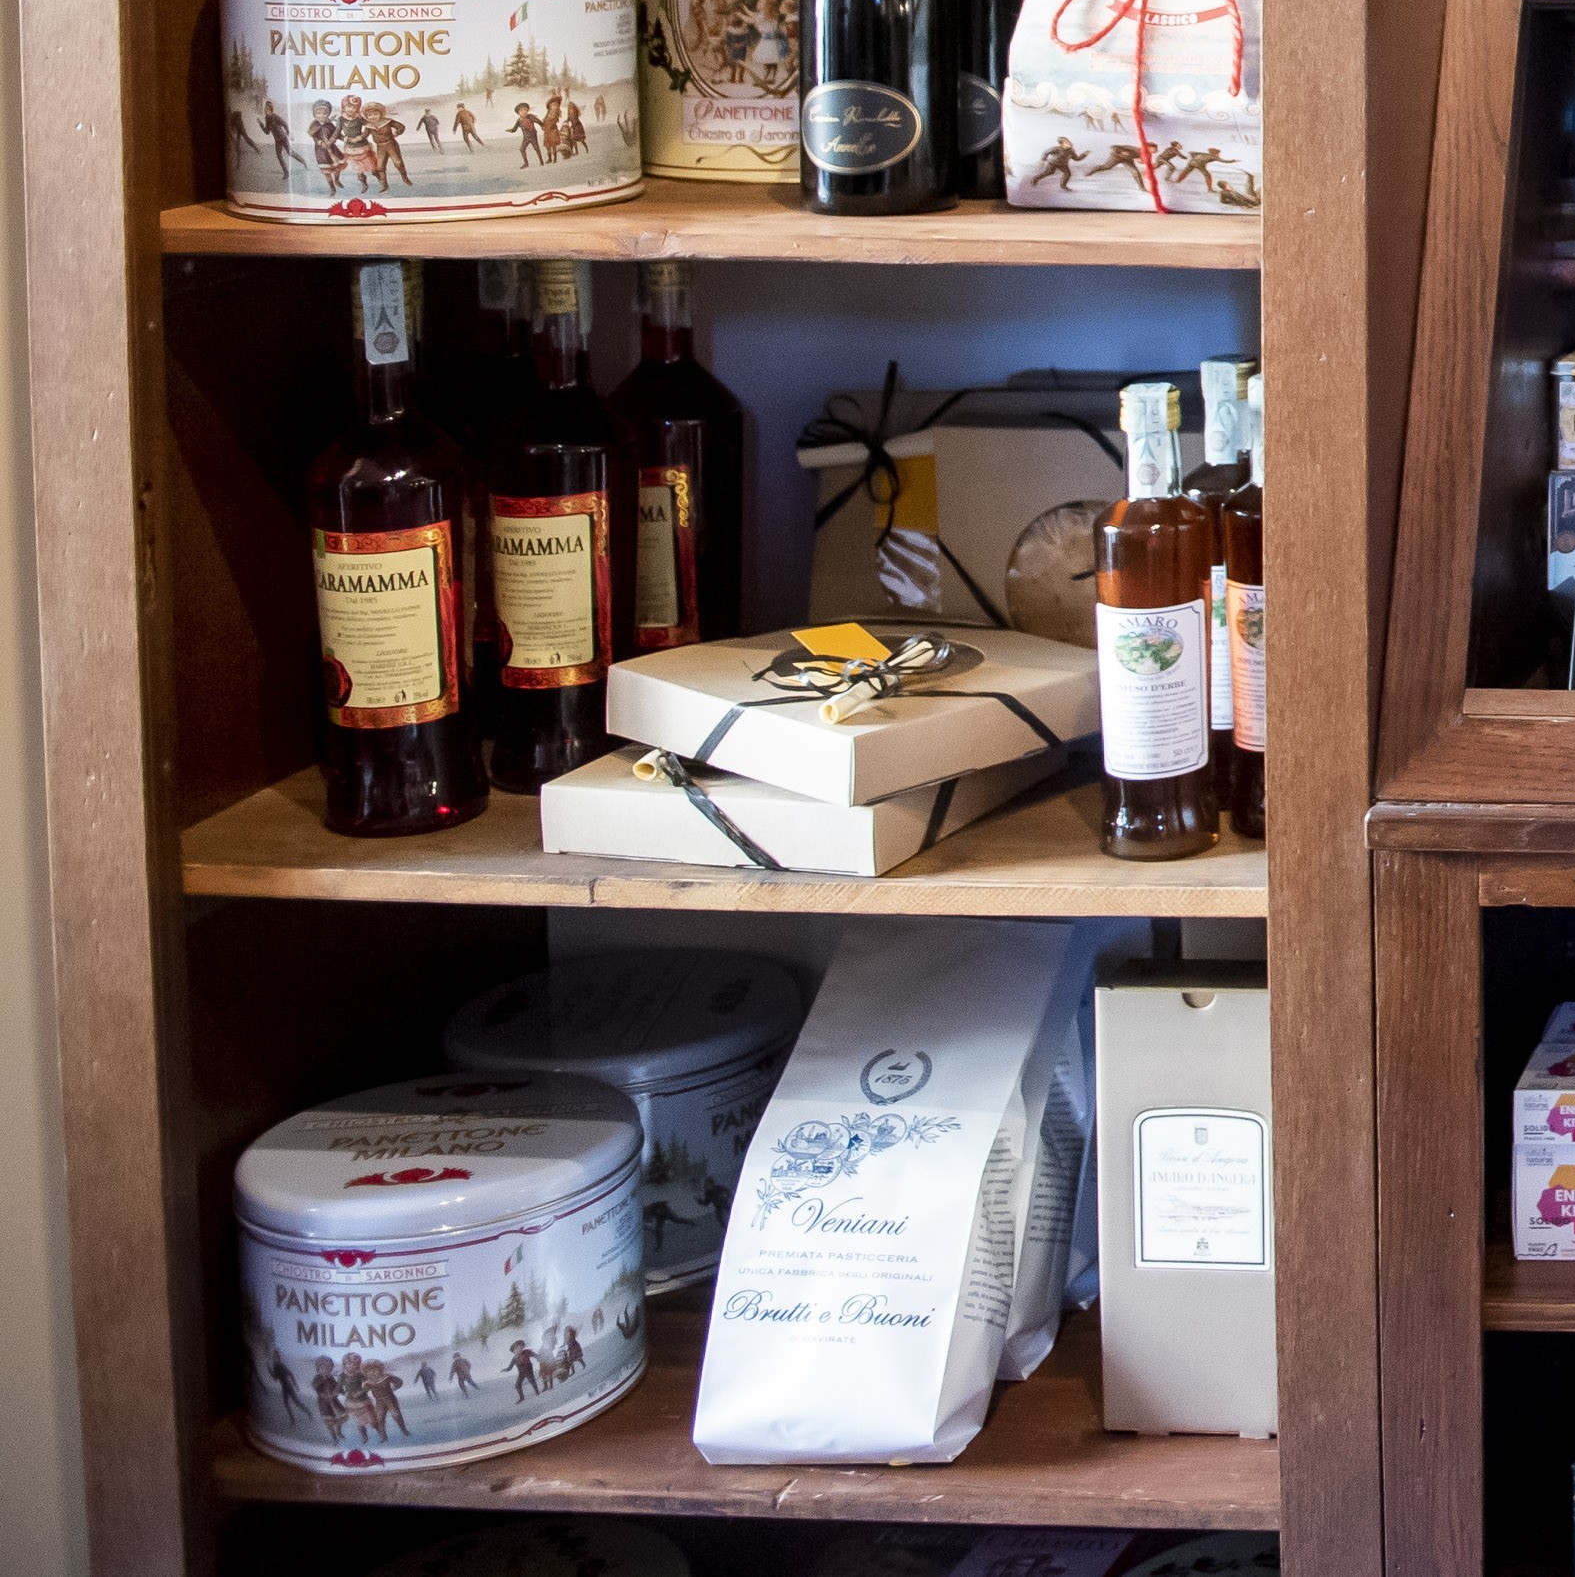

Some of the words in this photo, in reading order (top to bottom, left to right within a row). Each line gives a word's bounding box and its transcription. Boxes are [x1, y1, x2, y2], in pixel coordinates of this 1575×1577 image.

[270, 7, 332, 18] CHIOSTRO
[368, 7, 443, 18] SARONNO
[270, 29, 451, 57] PANETTONE
[293, 64, 420, 90] MILANO
[693, 103, 794, 121] PANETTONE
[791, 1197, 910, 1237] Veniani
[759, 1249, 824, 1261] PREMIATA
[828, 1251, 918, 1263] PASTICCERIA
[276, 1284, 445, 1316] PANETTONE
[723, 1289, 816, 1321] Brutti
[819, 1309, 831, 1321] e
[838, 1294, 935, 1329] Buoni
[297, 1322, 416, 1348] MILANO
